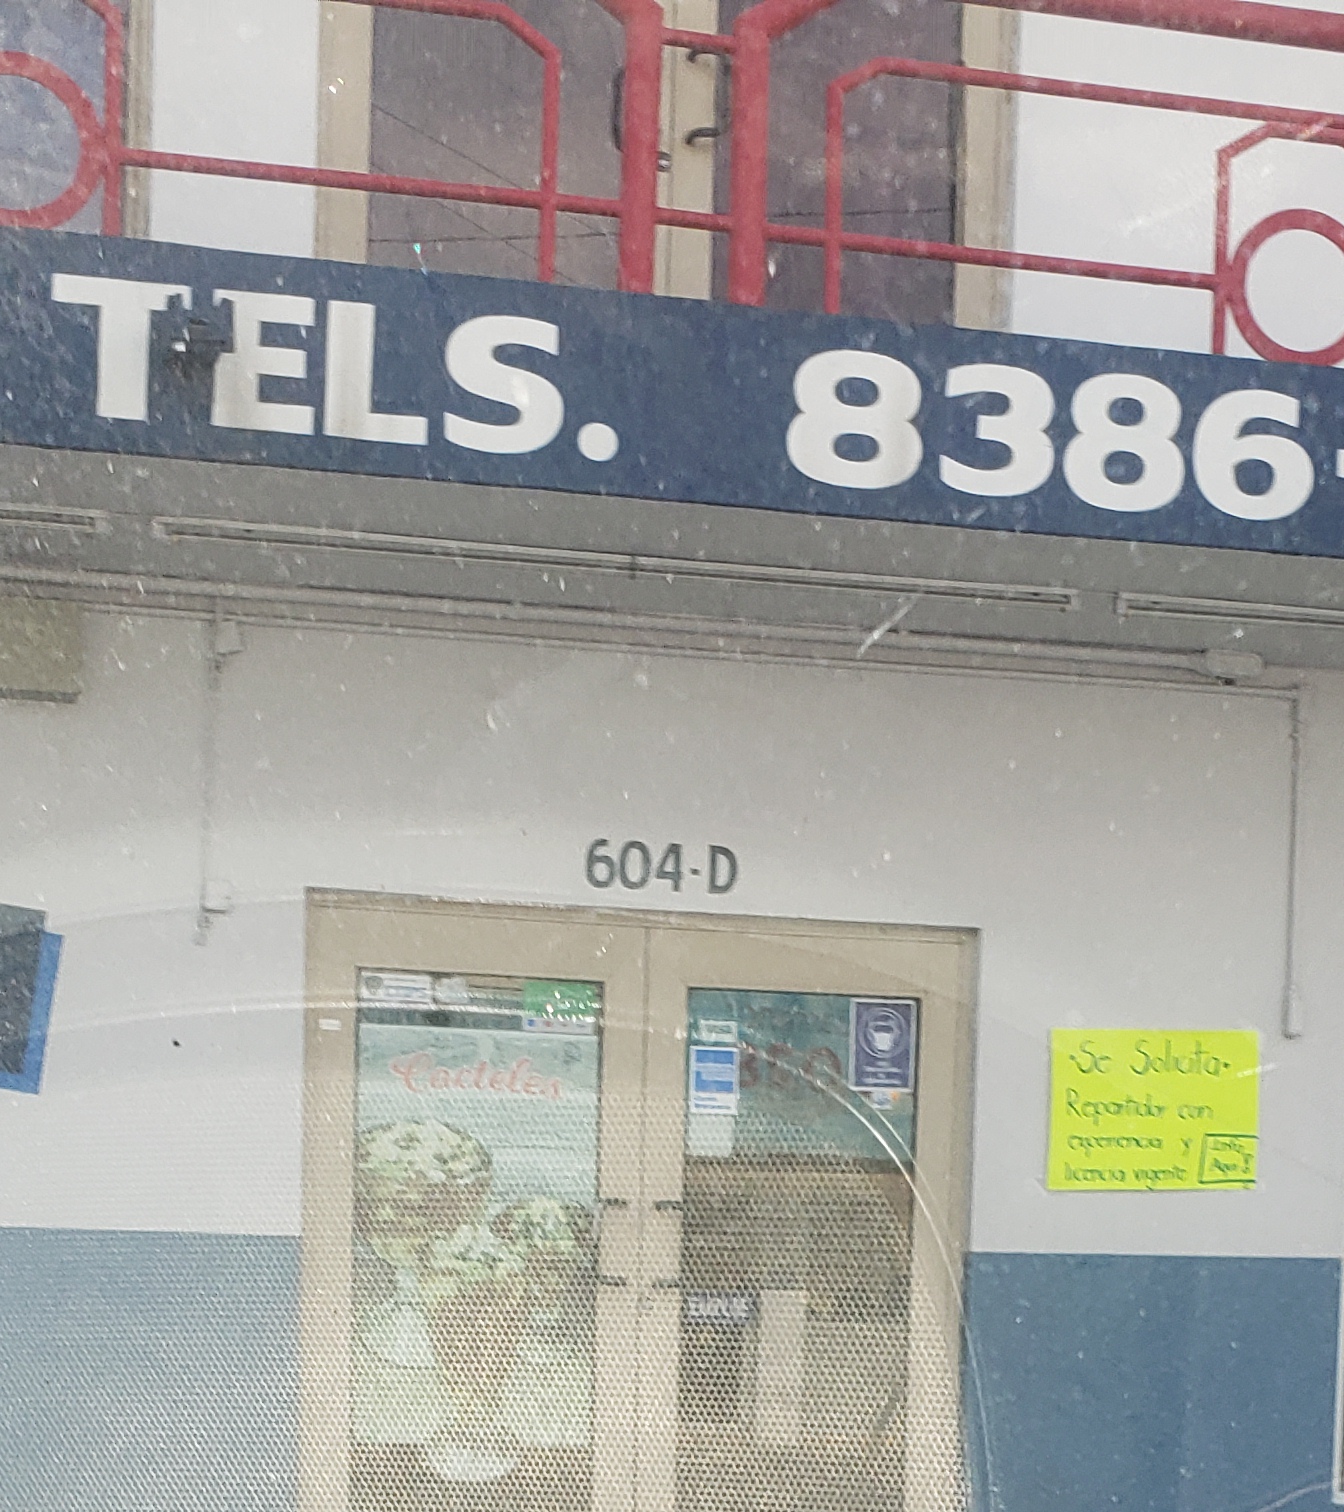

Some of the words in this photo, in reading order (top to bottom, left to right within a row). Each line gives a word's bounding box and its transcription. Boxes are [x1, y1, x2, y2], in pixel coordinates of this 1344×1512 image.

[52, 272, 620, 462] TELS.
[585, 837, 739, 896] 604-D
[1069, 1039, 1112, 1075] Se
[1176, 1103, 1214, 1120] con
